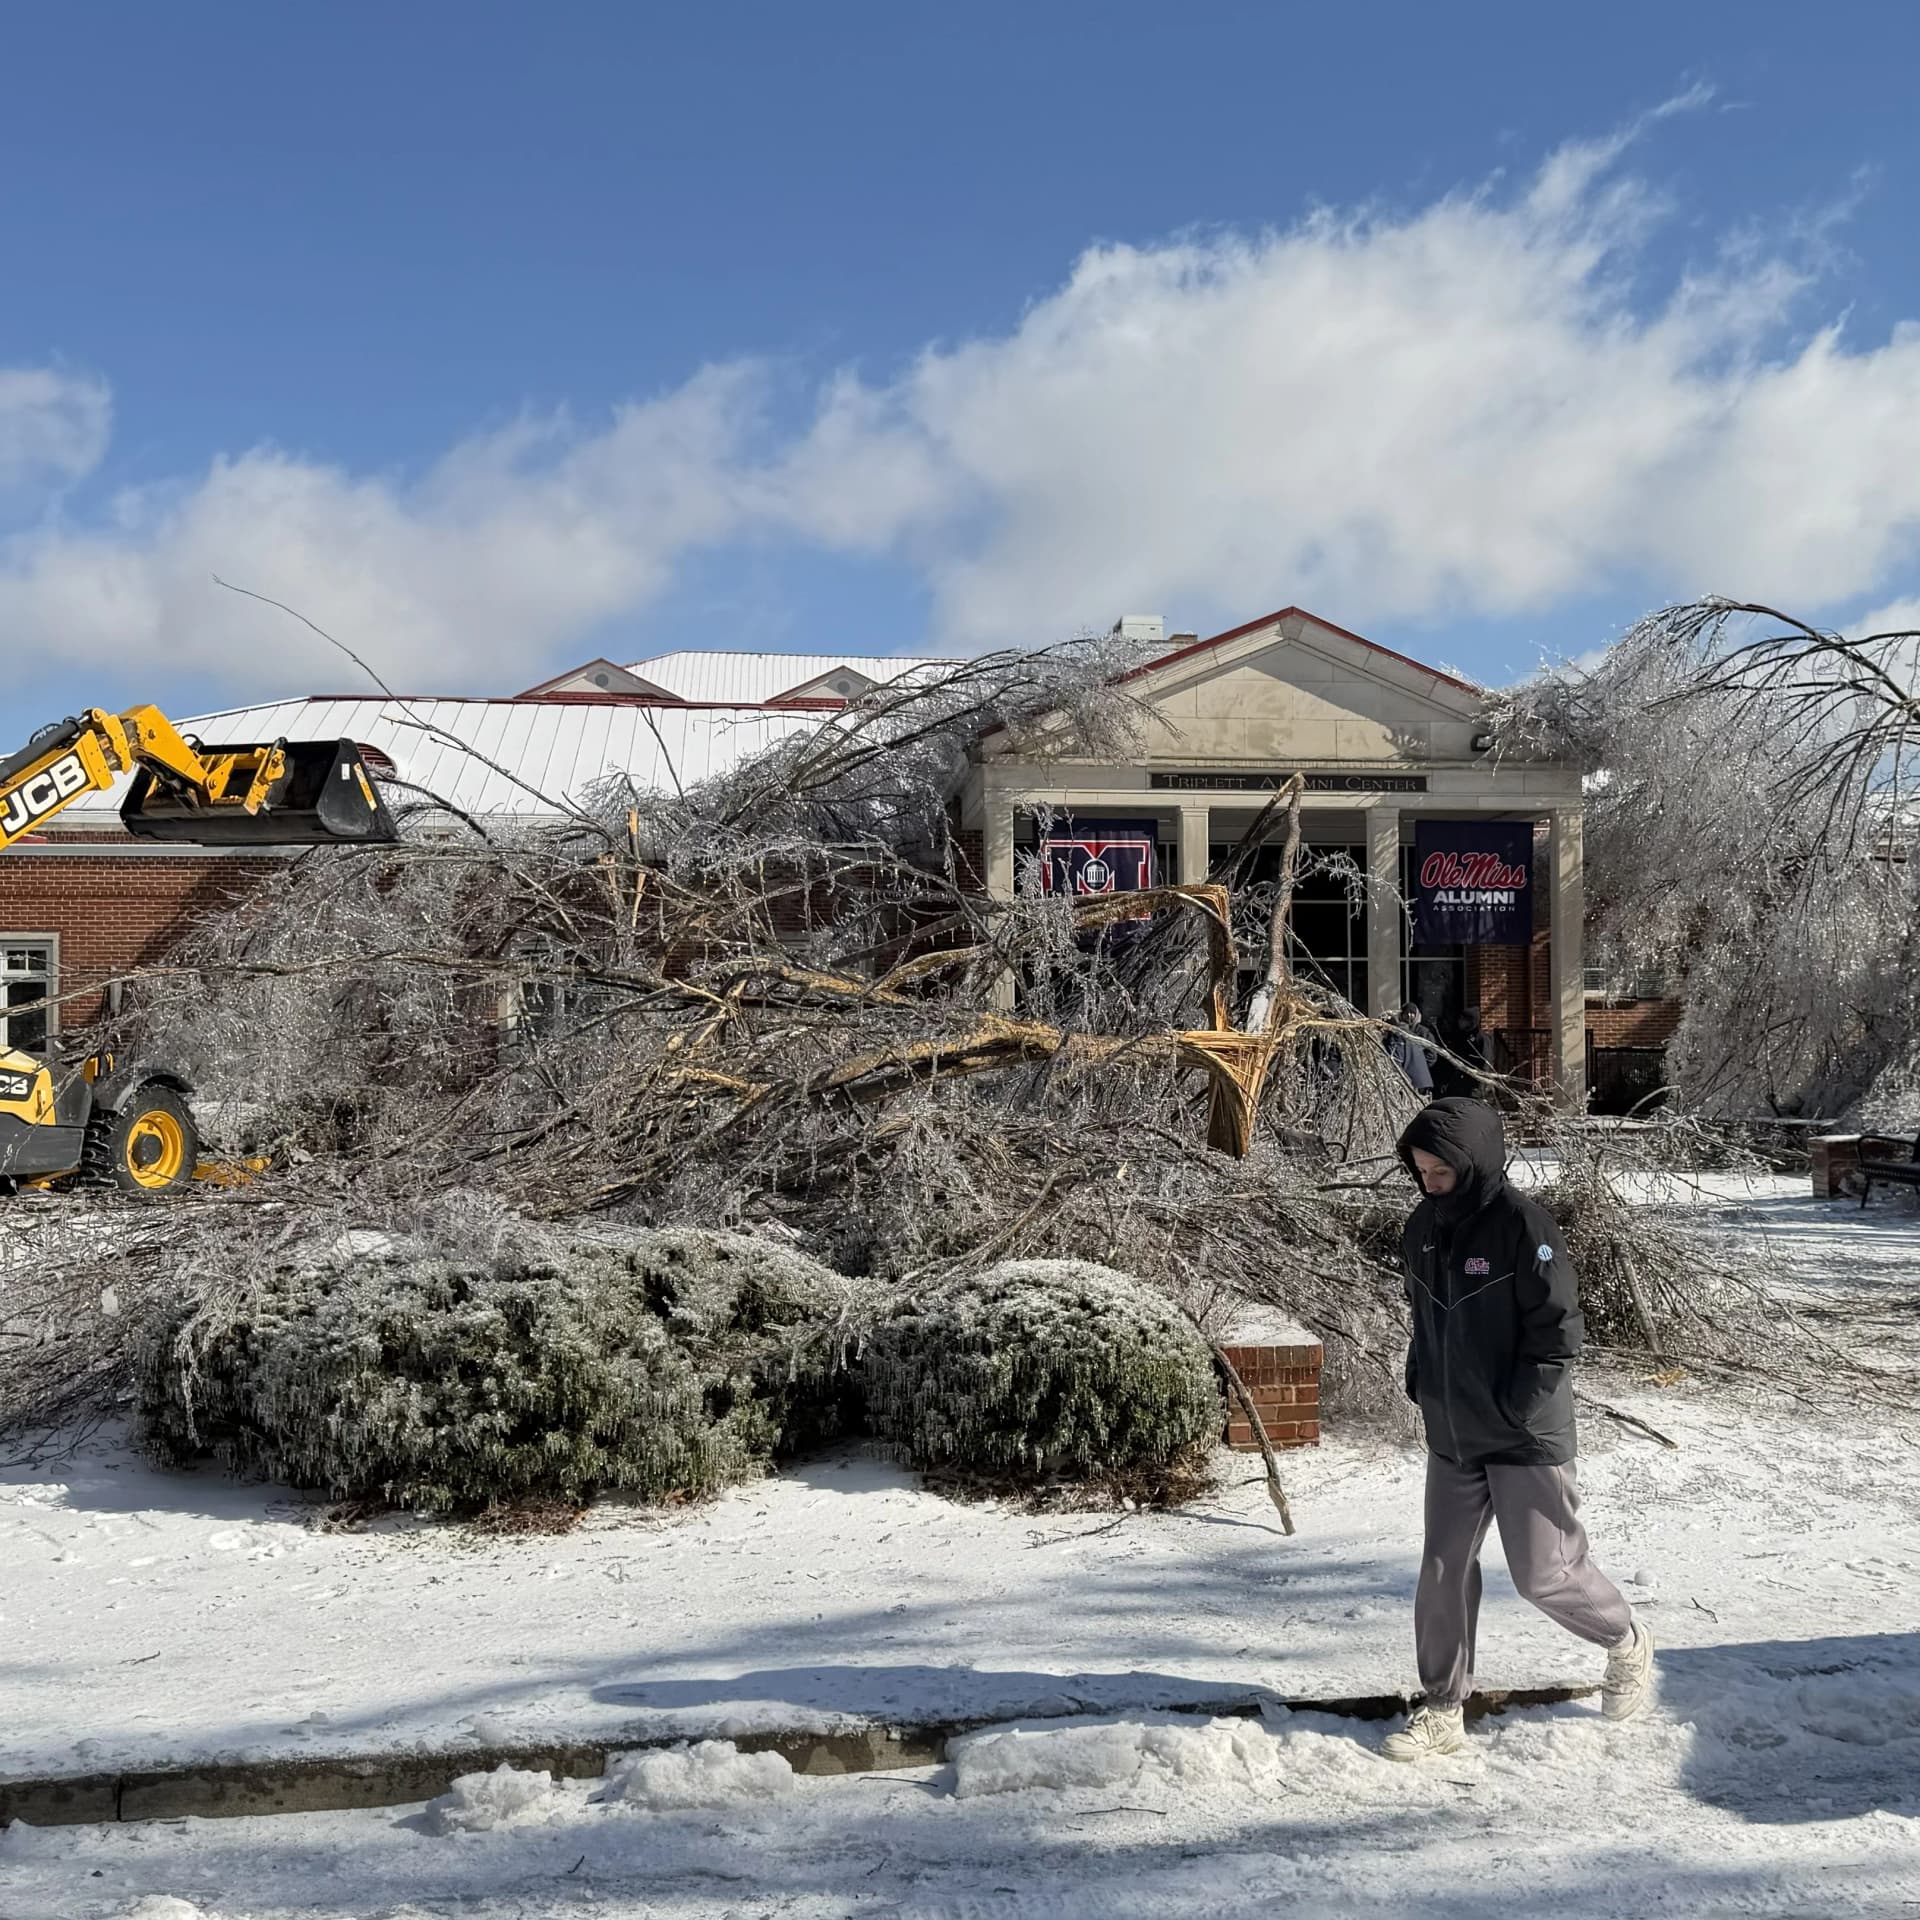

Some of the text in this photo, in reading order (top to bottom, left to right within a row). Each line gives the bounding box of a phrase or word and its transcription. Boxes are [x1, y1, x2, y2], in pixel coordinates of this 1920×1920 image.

[2, 755, 87, 832] JCB
[1421, 852, 1527, 888] Ole Miss
[1433, 891, 1515, 904] ALUMNI
[0, 1075, 28, 1095] CB
